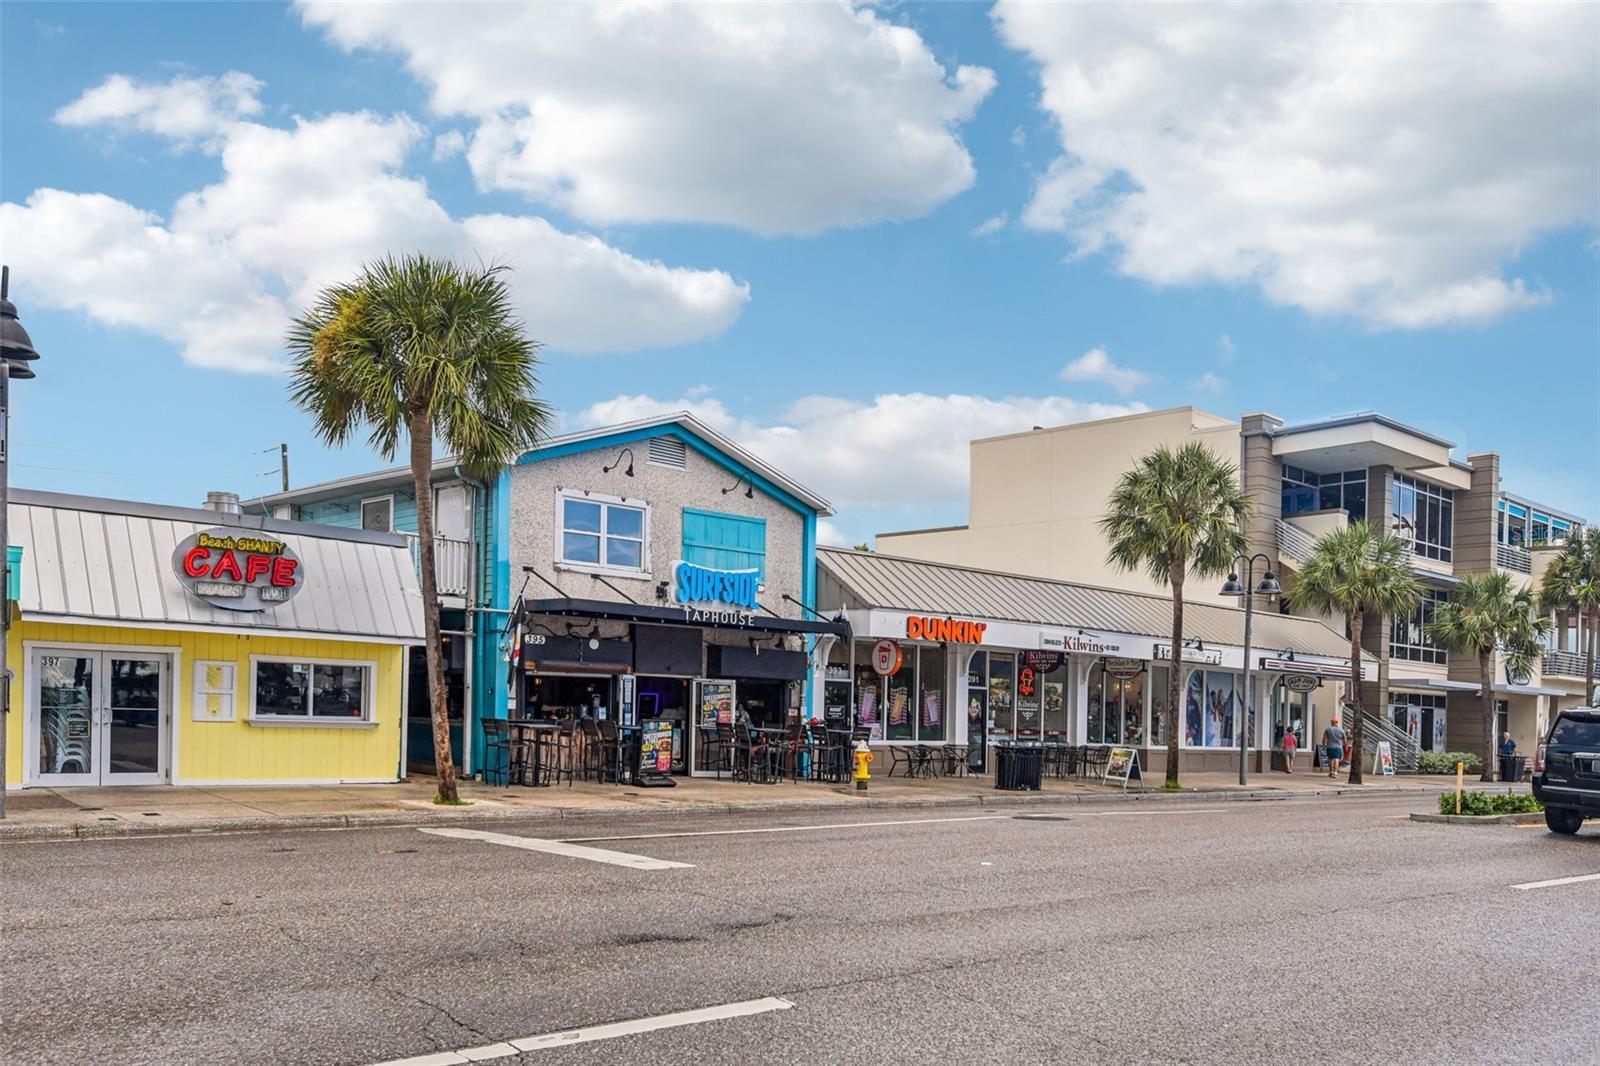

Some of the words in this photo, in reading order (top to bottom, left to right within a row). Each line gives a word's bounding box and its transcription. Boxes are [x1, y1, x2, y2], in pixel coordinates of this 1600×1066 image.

[199, 535, 234, 549] Beach
[237, 539, 285, 554] SHANTY
[184, 546, 298, 586] CAFE
[677, 562, 760, 609] SURFSIDE
[683, 605, 755, 626] TAPHOUSE
[527, 635, 544, 644] 395
[907, 616, 986, 644] DUNKIN'
[1063, 636, 1104, 653] Kilwins
[42, 657, 59, 666] 397
